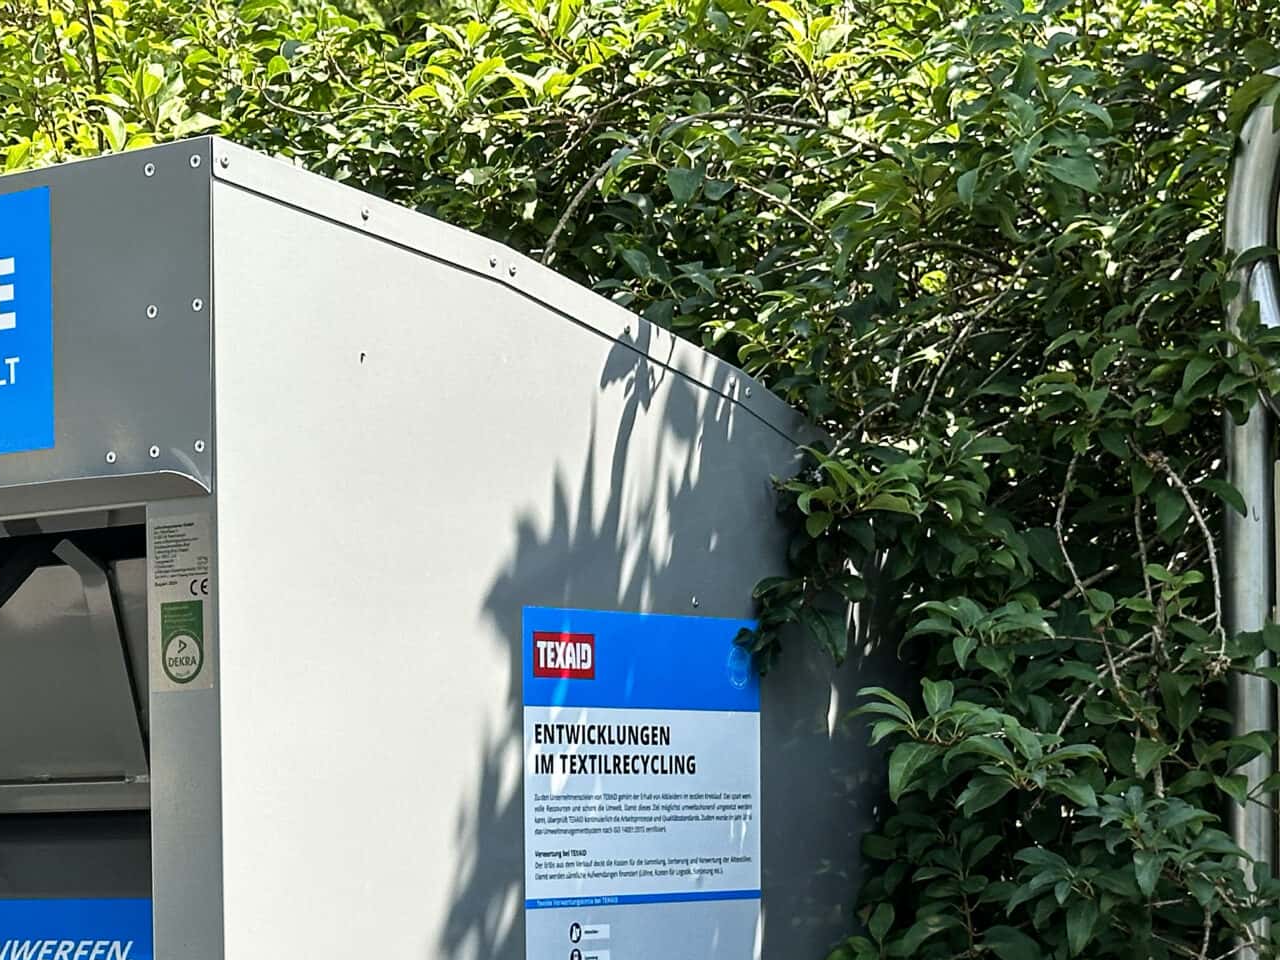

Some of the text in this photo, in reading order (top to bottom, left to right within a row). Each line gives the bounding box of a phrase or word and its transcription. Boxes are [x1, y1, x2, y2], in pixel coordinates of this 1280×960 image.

[167, 655, 197, 668] DEKRA
[536, 640, 593, 670] TEXAID
[534, 723, 671, 746] ENTWICKLUNGEN
[534, 753, 697, 775] IM TEXTILRECYCLING
